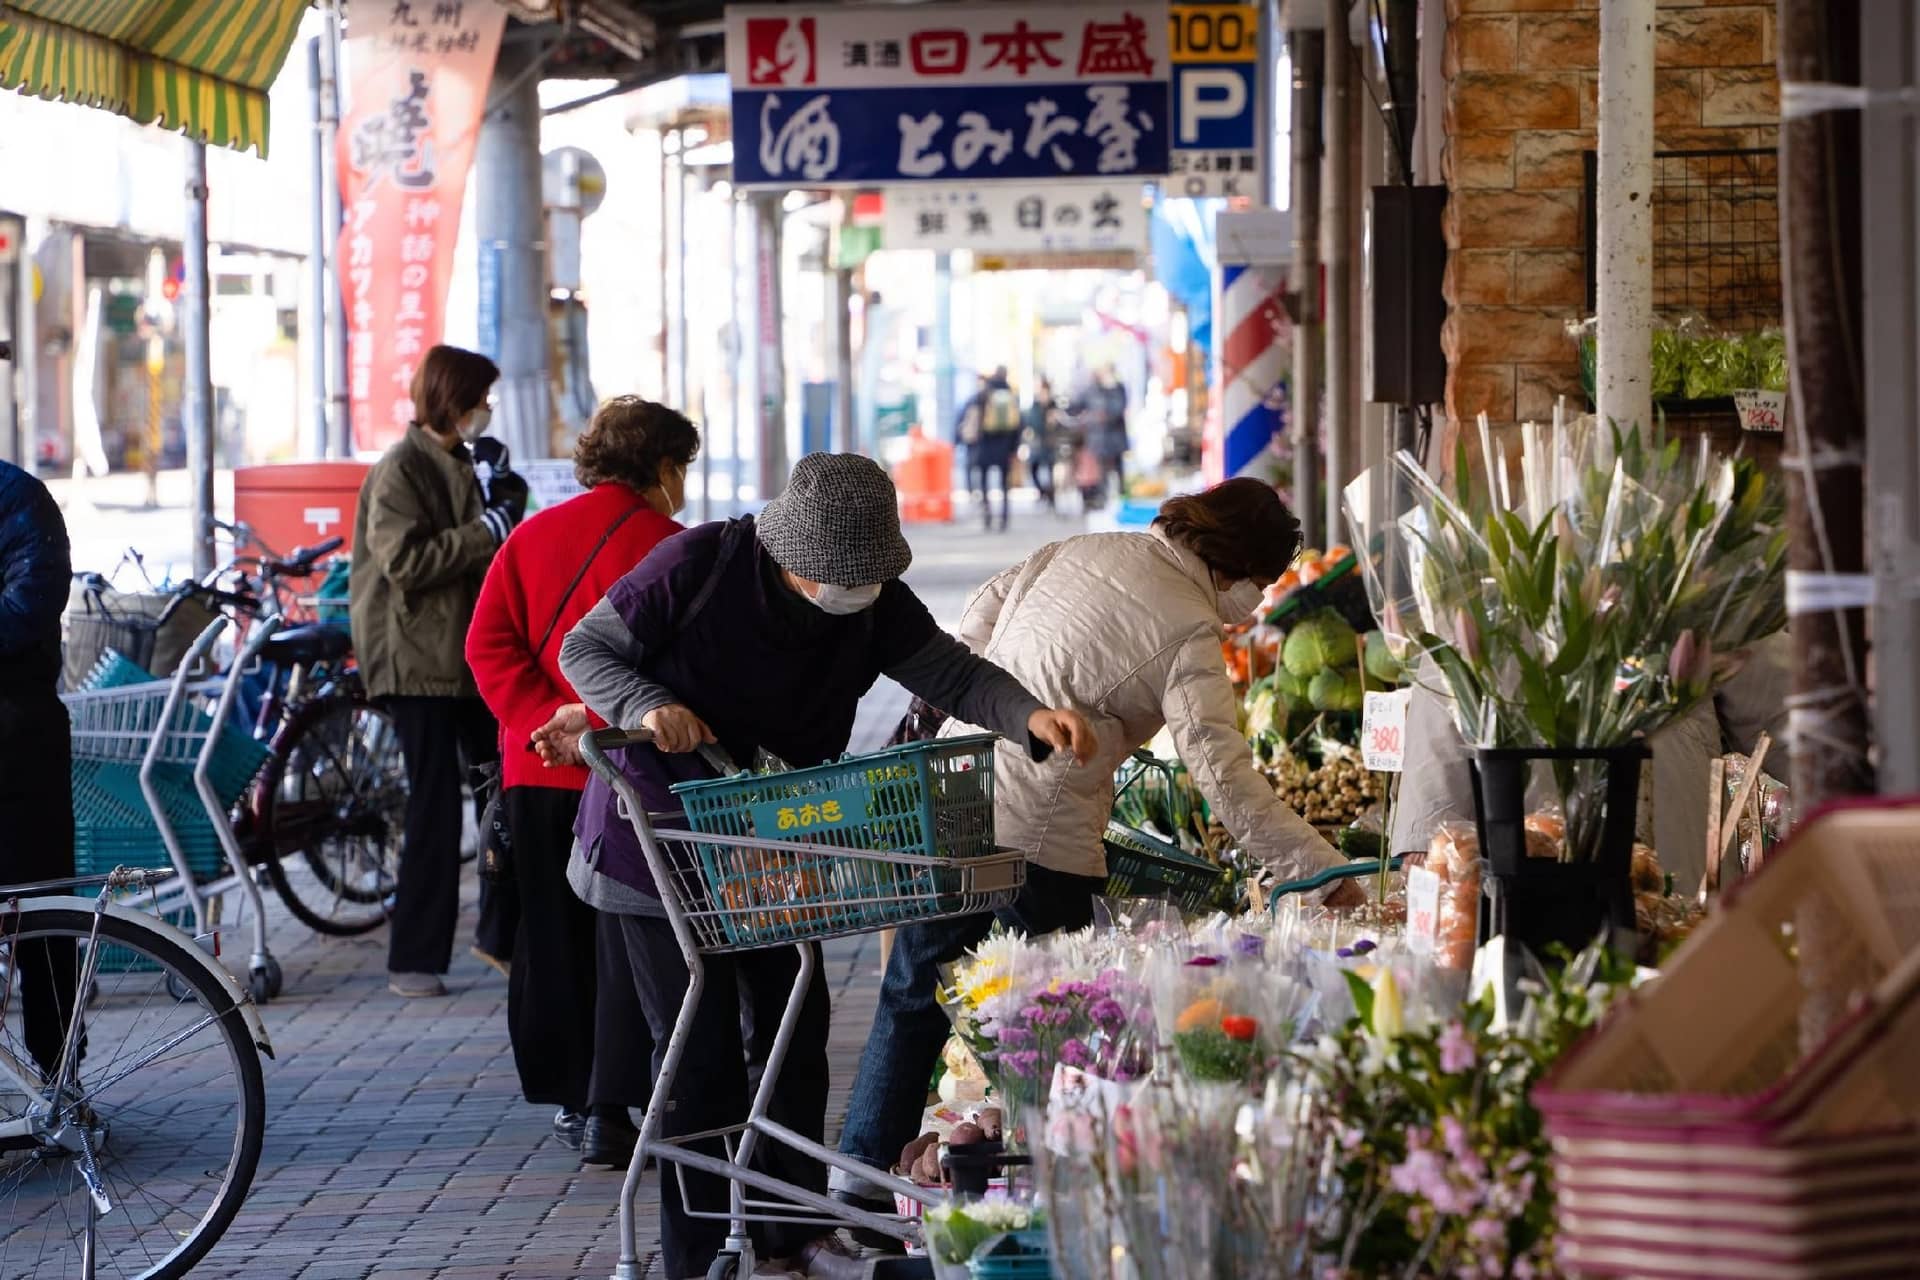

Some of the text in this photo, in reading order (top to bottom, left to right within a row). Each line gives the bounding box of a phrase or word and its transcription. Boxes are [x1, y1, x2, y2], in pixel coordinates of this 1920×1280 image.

[388, 0, 463, 28] 九州
[842, 15, 1155, 78] 清酒 日本盛
[1180, 70, 1247, 143] P
[759, 93, 841, 180] 酒
[1015, 191, 1122, 230] 日の出
[777, 799, 844, 830] あおき
